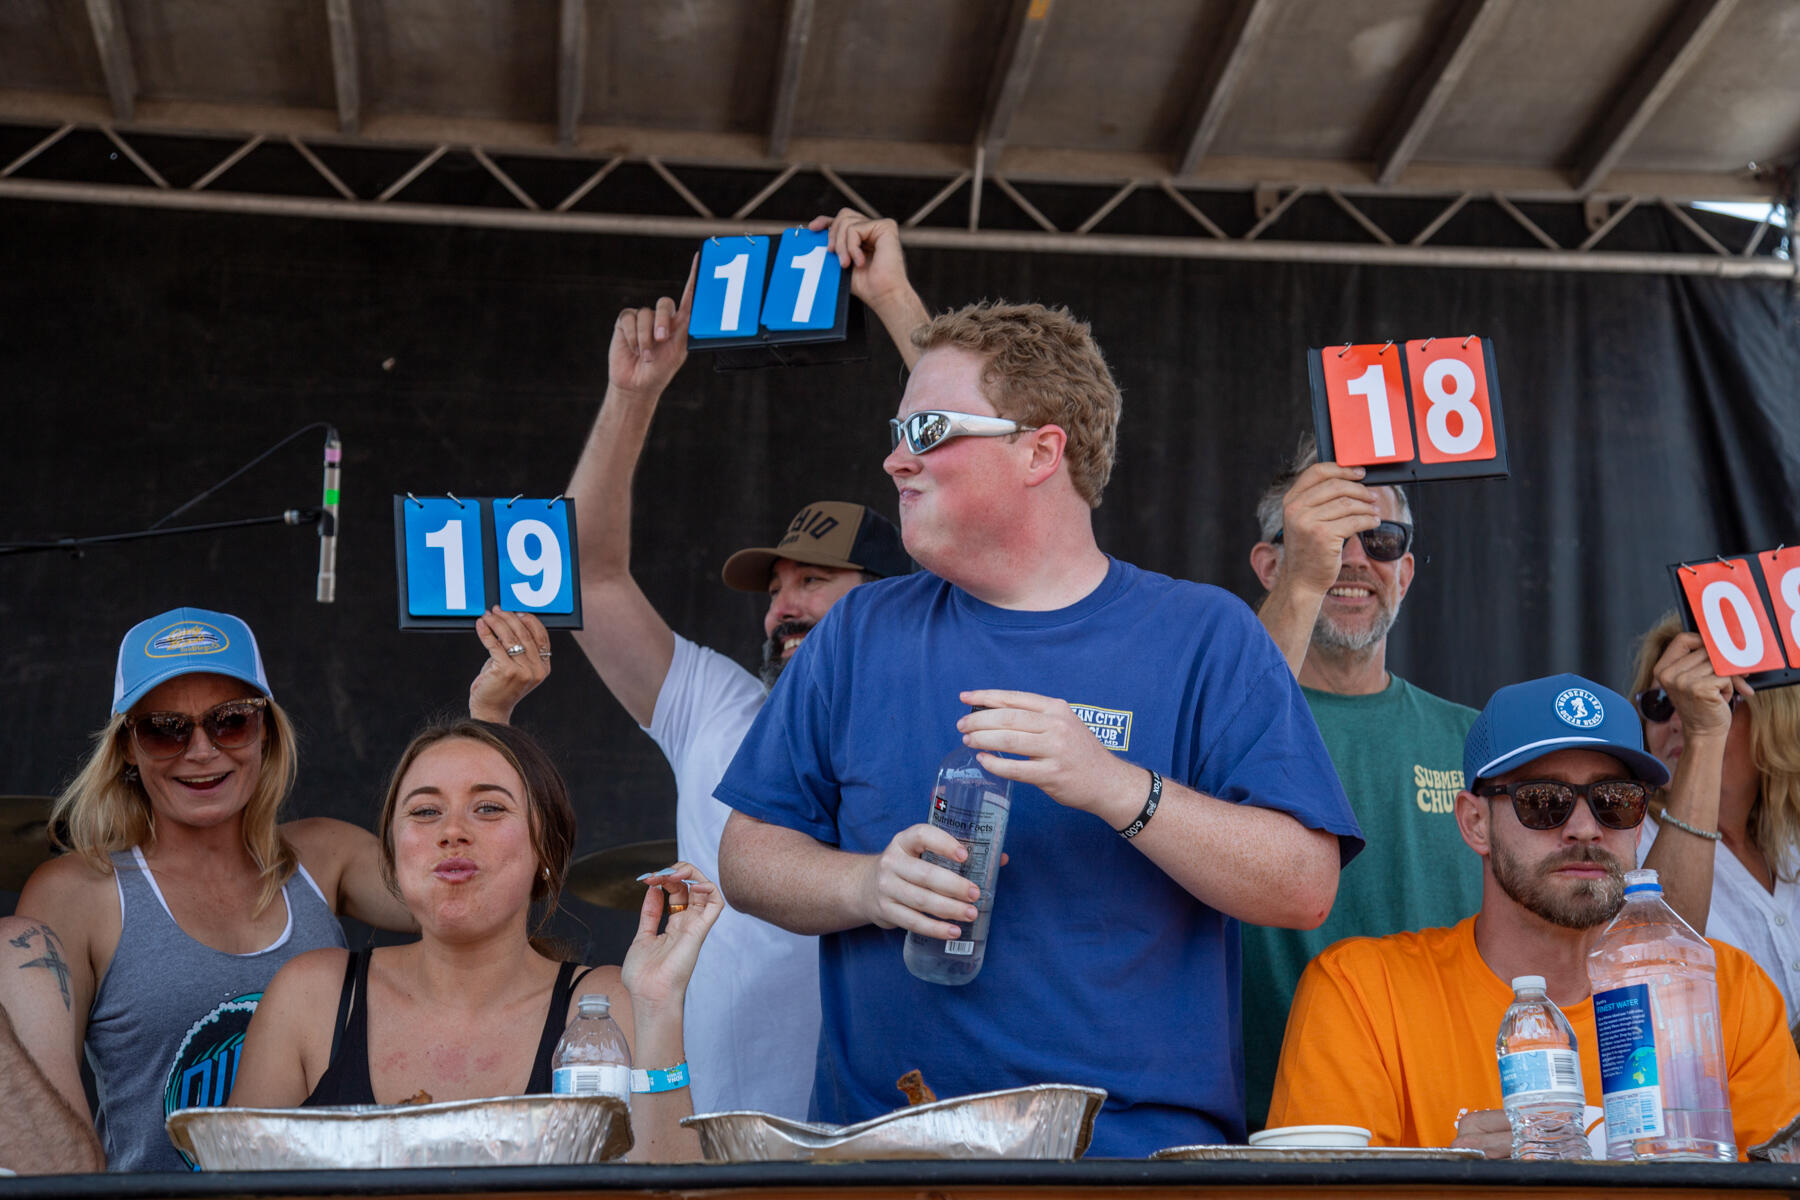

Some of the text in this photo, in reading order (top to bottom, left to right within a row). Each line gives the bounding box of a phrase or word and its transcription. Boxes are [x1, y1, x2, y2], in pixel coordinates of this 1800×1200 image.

[714, 246, 828, 331] 11
[1347, 358, 1484, 458] 18
[425, 519, 562, 608] 19
[1095, 712, 1125, 727] CITY
[933, 811, 967, 830] Nutrition
[968, 822, 993, 832] Facts
[1616, 998, 1639, 1009] WATER
